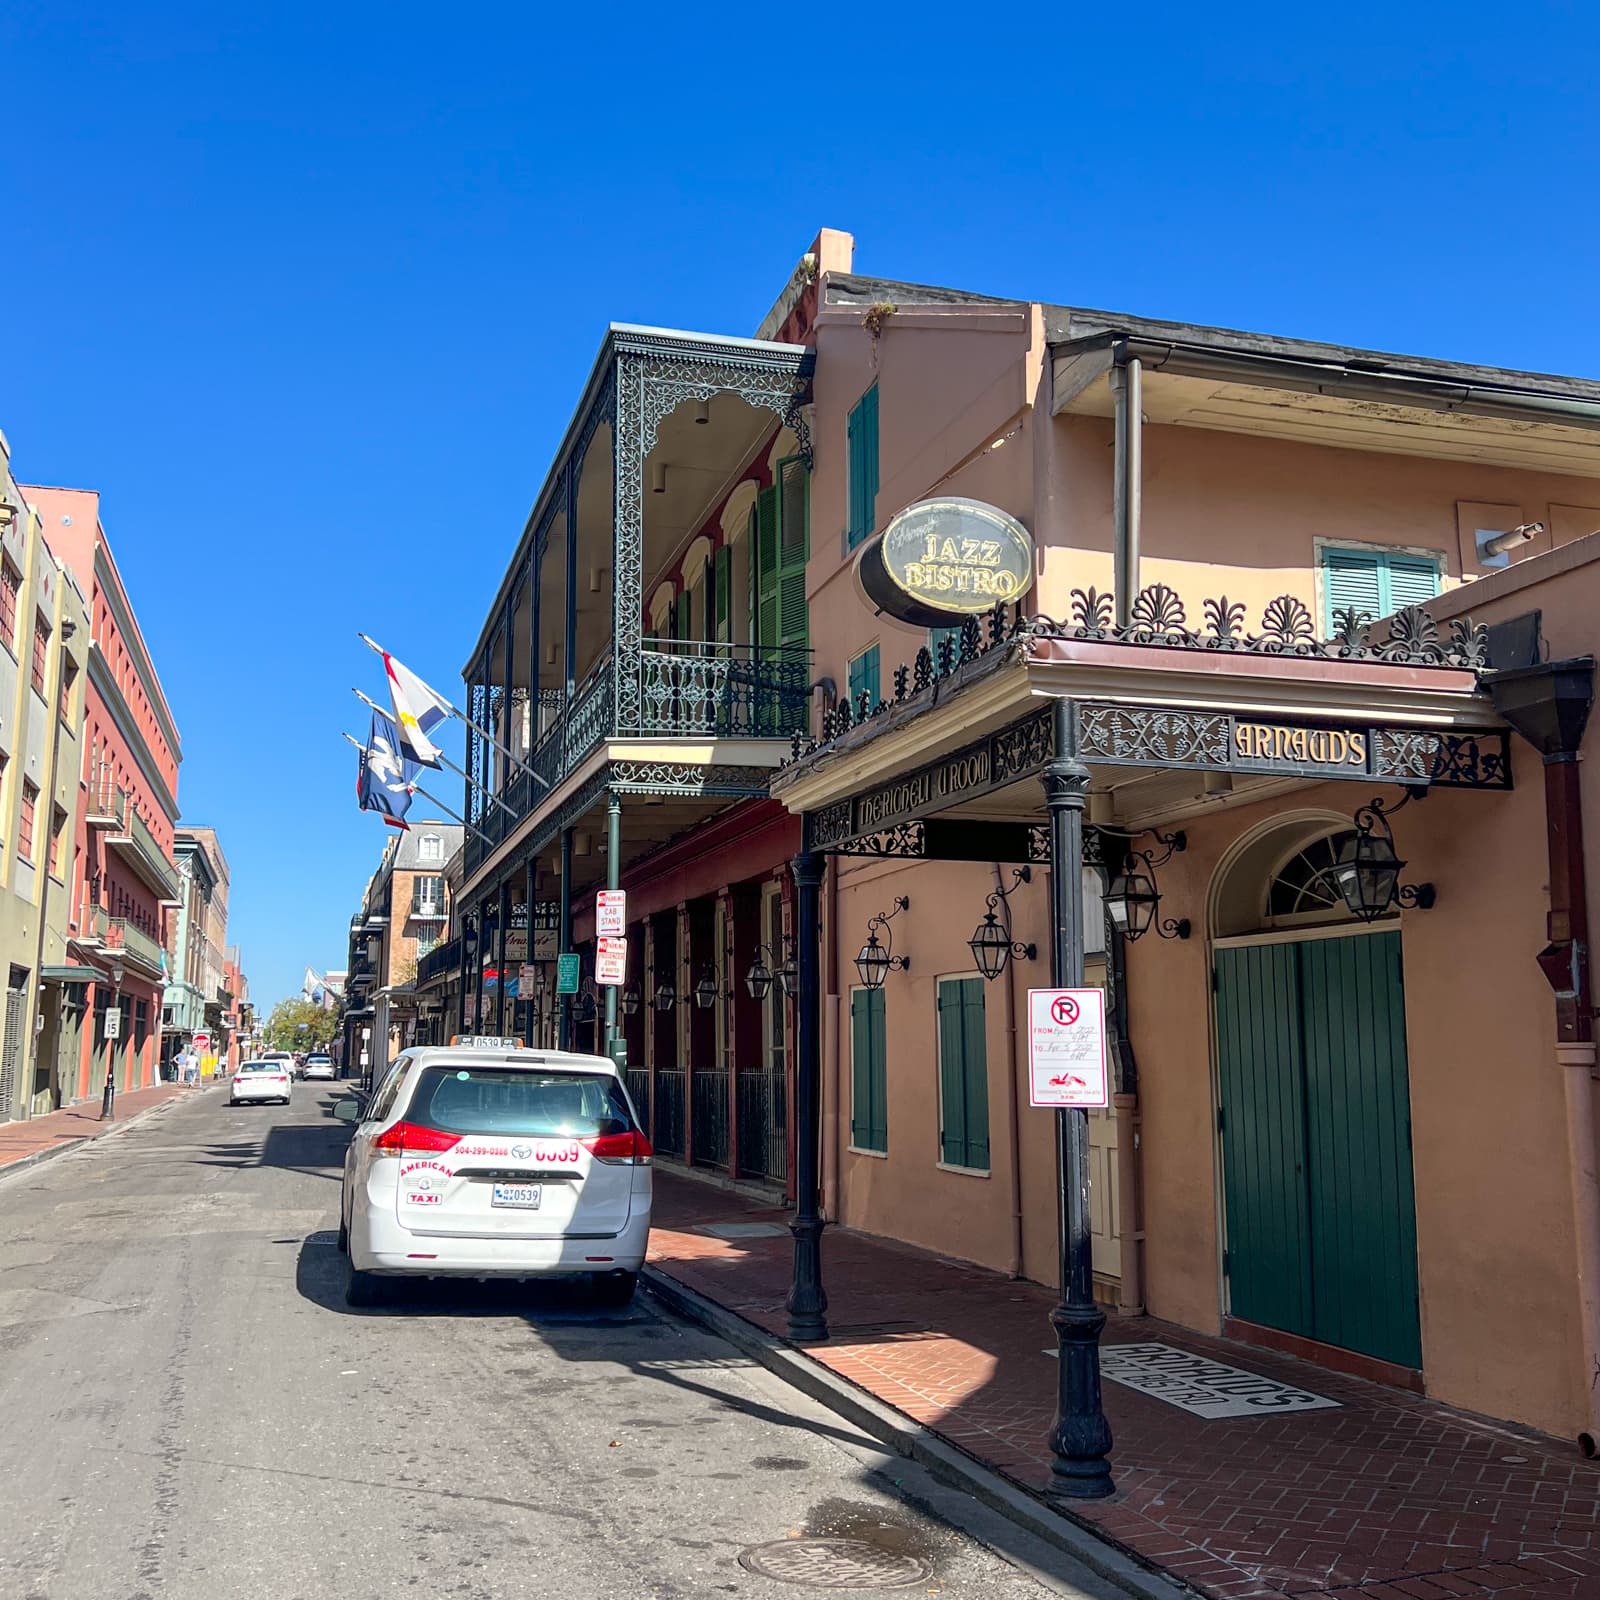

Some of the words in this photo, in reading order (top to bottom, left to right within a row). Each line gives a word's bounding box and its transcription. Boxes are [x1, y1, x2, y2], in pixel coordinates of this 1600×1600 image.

[920, 533, 1002, 566] JAZZ
[904, 562, 1018, 596] BISTRO
[1235, 724, 1367, 765] ARNAUD'S
[950, 751, 989, 792] ROOM
[604, 907, 617, 916] CAB
[600, 917, 621, 926] STAND
[107, 1023, 117, 1035] 15
[476, 1037, 499, 1048] 0539
[400, 1161, 454, 1178] AMERICAN
[410, 1194, 439, 1203] TAXI
[514, 1189, 539, 1201] 0539
[1104, 1345, 1316, 1407] ARNAUD'S
[1122, 1373, 1231, 1406] BISTRO
